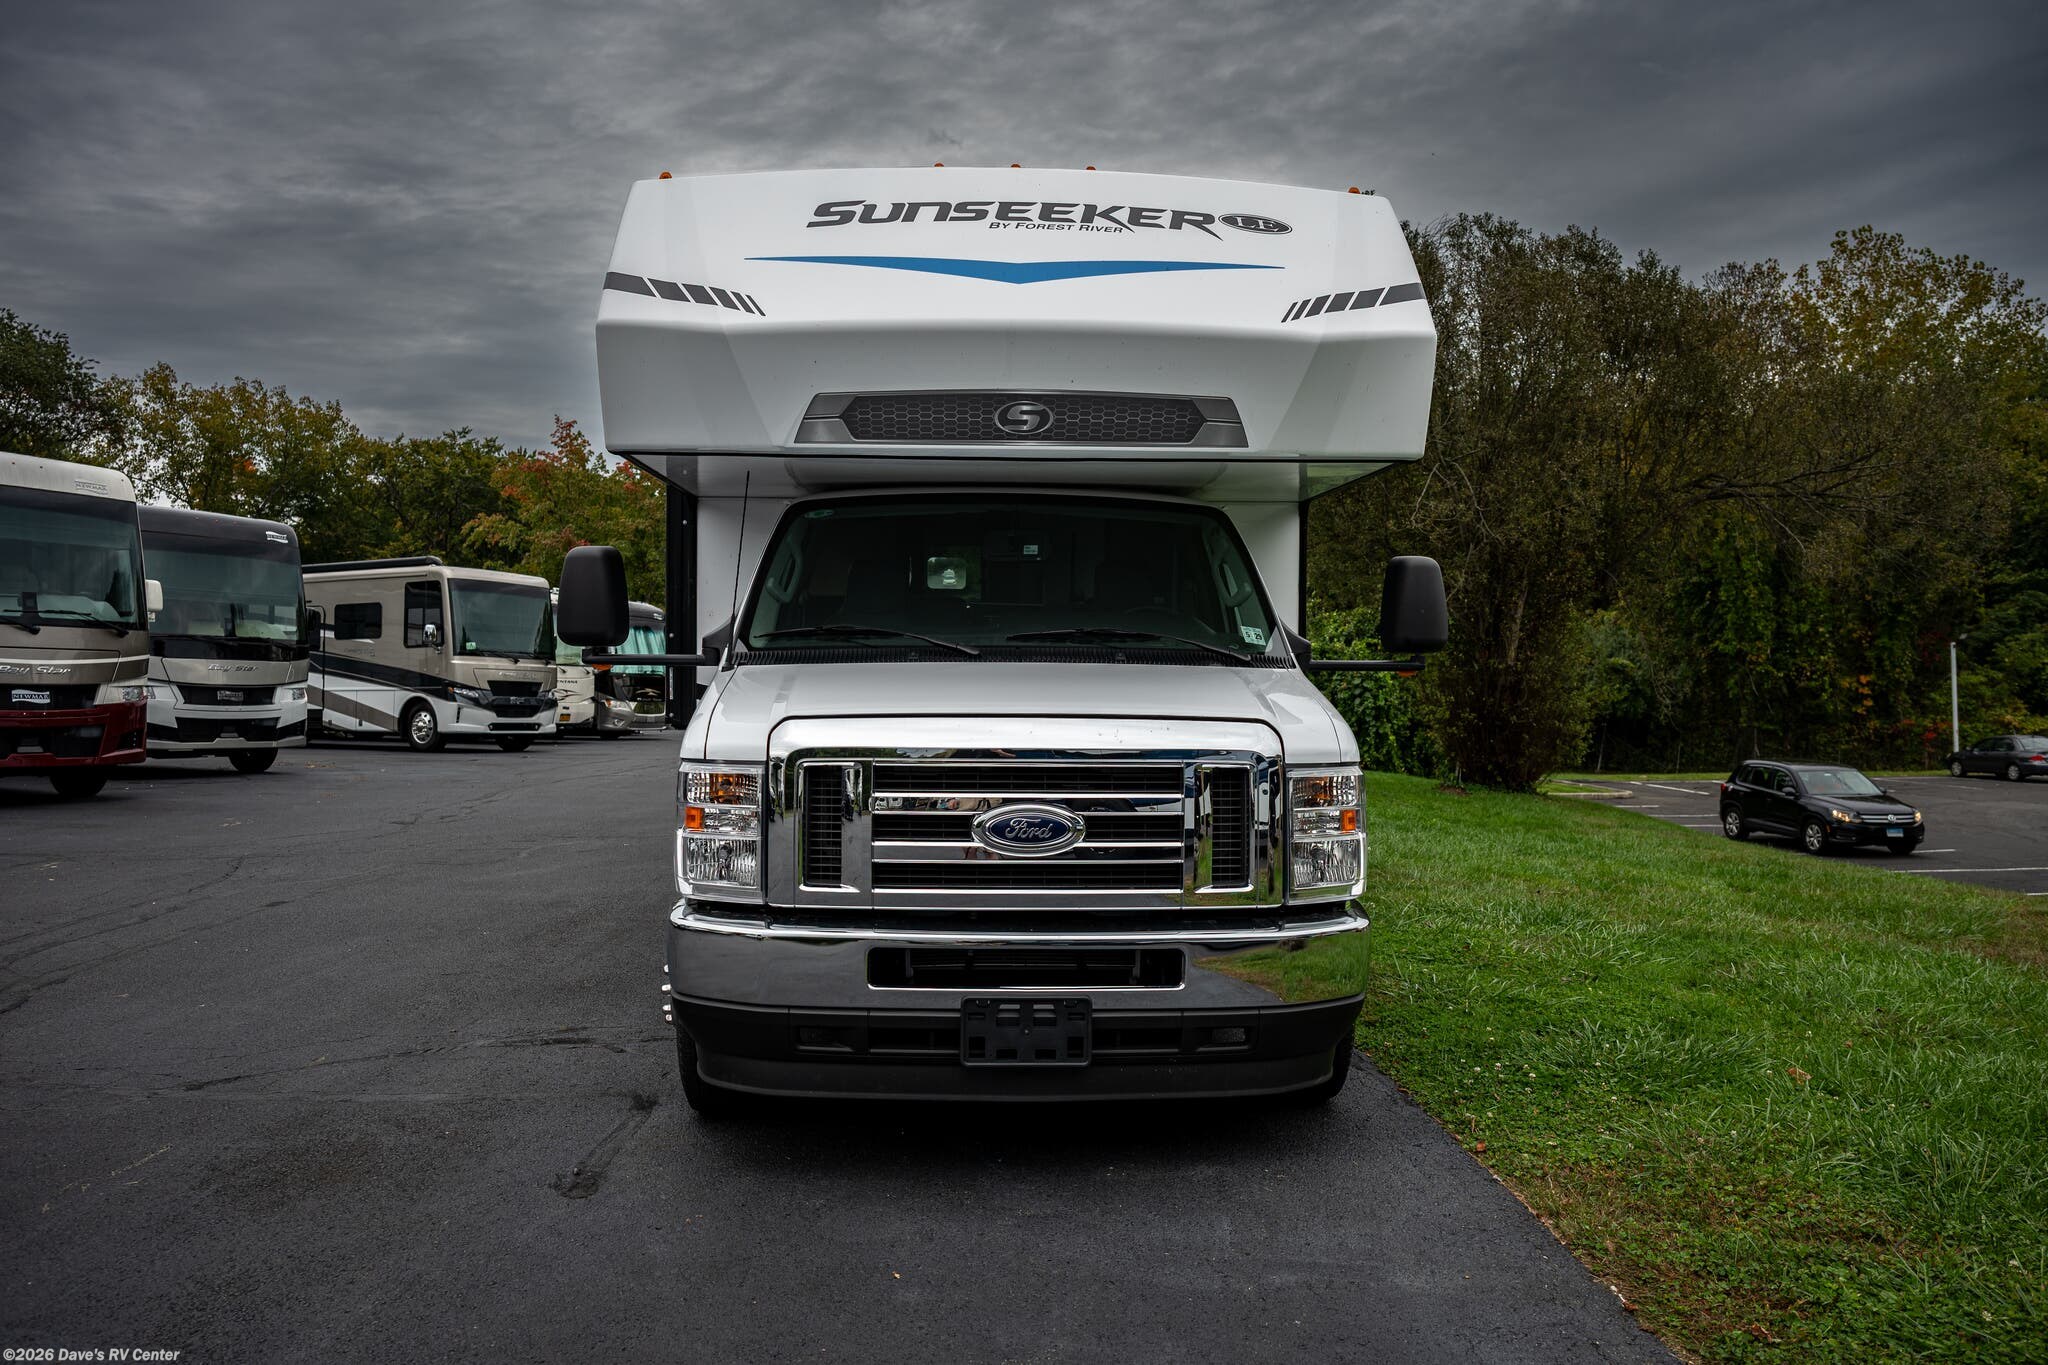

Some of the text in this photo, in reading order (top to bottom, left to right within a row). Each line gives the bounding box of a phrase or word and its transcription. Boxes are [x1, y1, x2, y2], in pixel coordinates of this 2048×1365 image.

[806, 199, 1280, 241] SUNSEEKER LE
[1005, 818, 1053, 838] Ford
